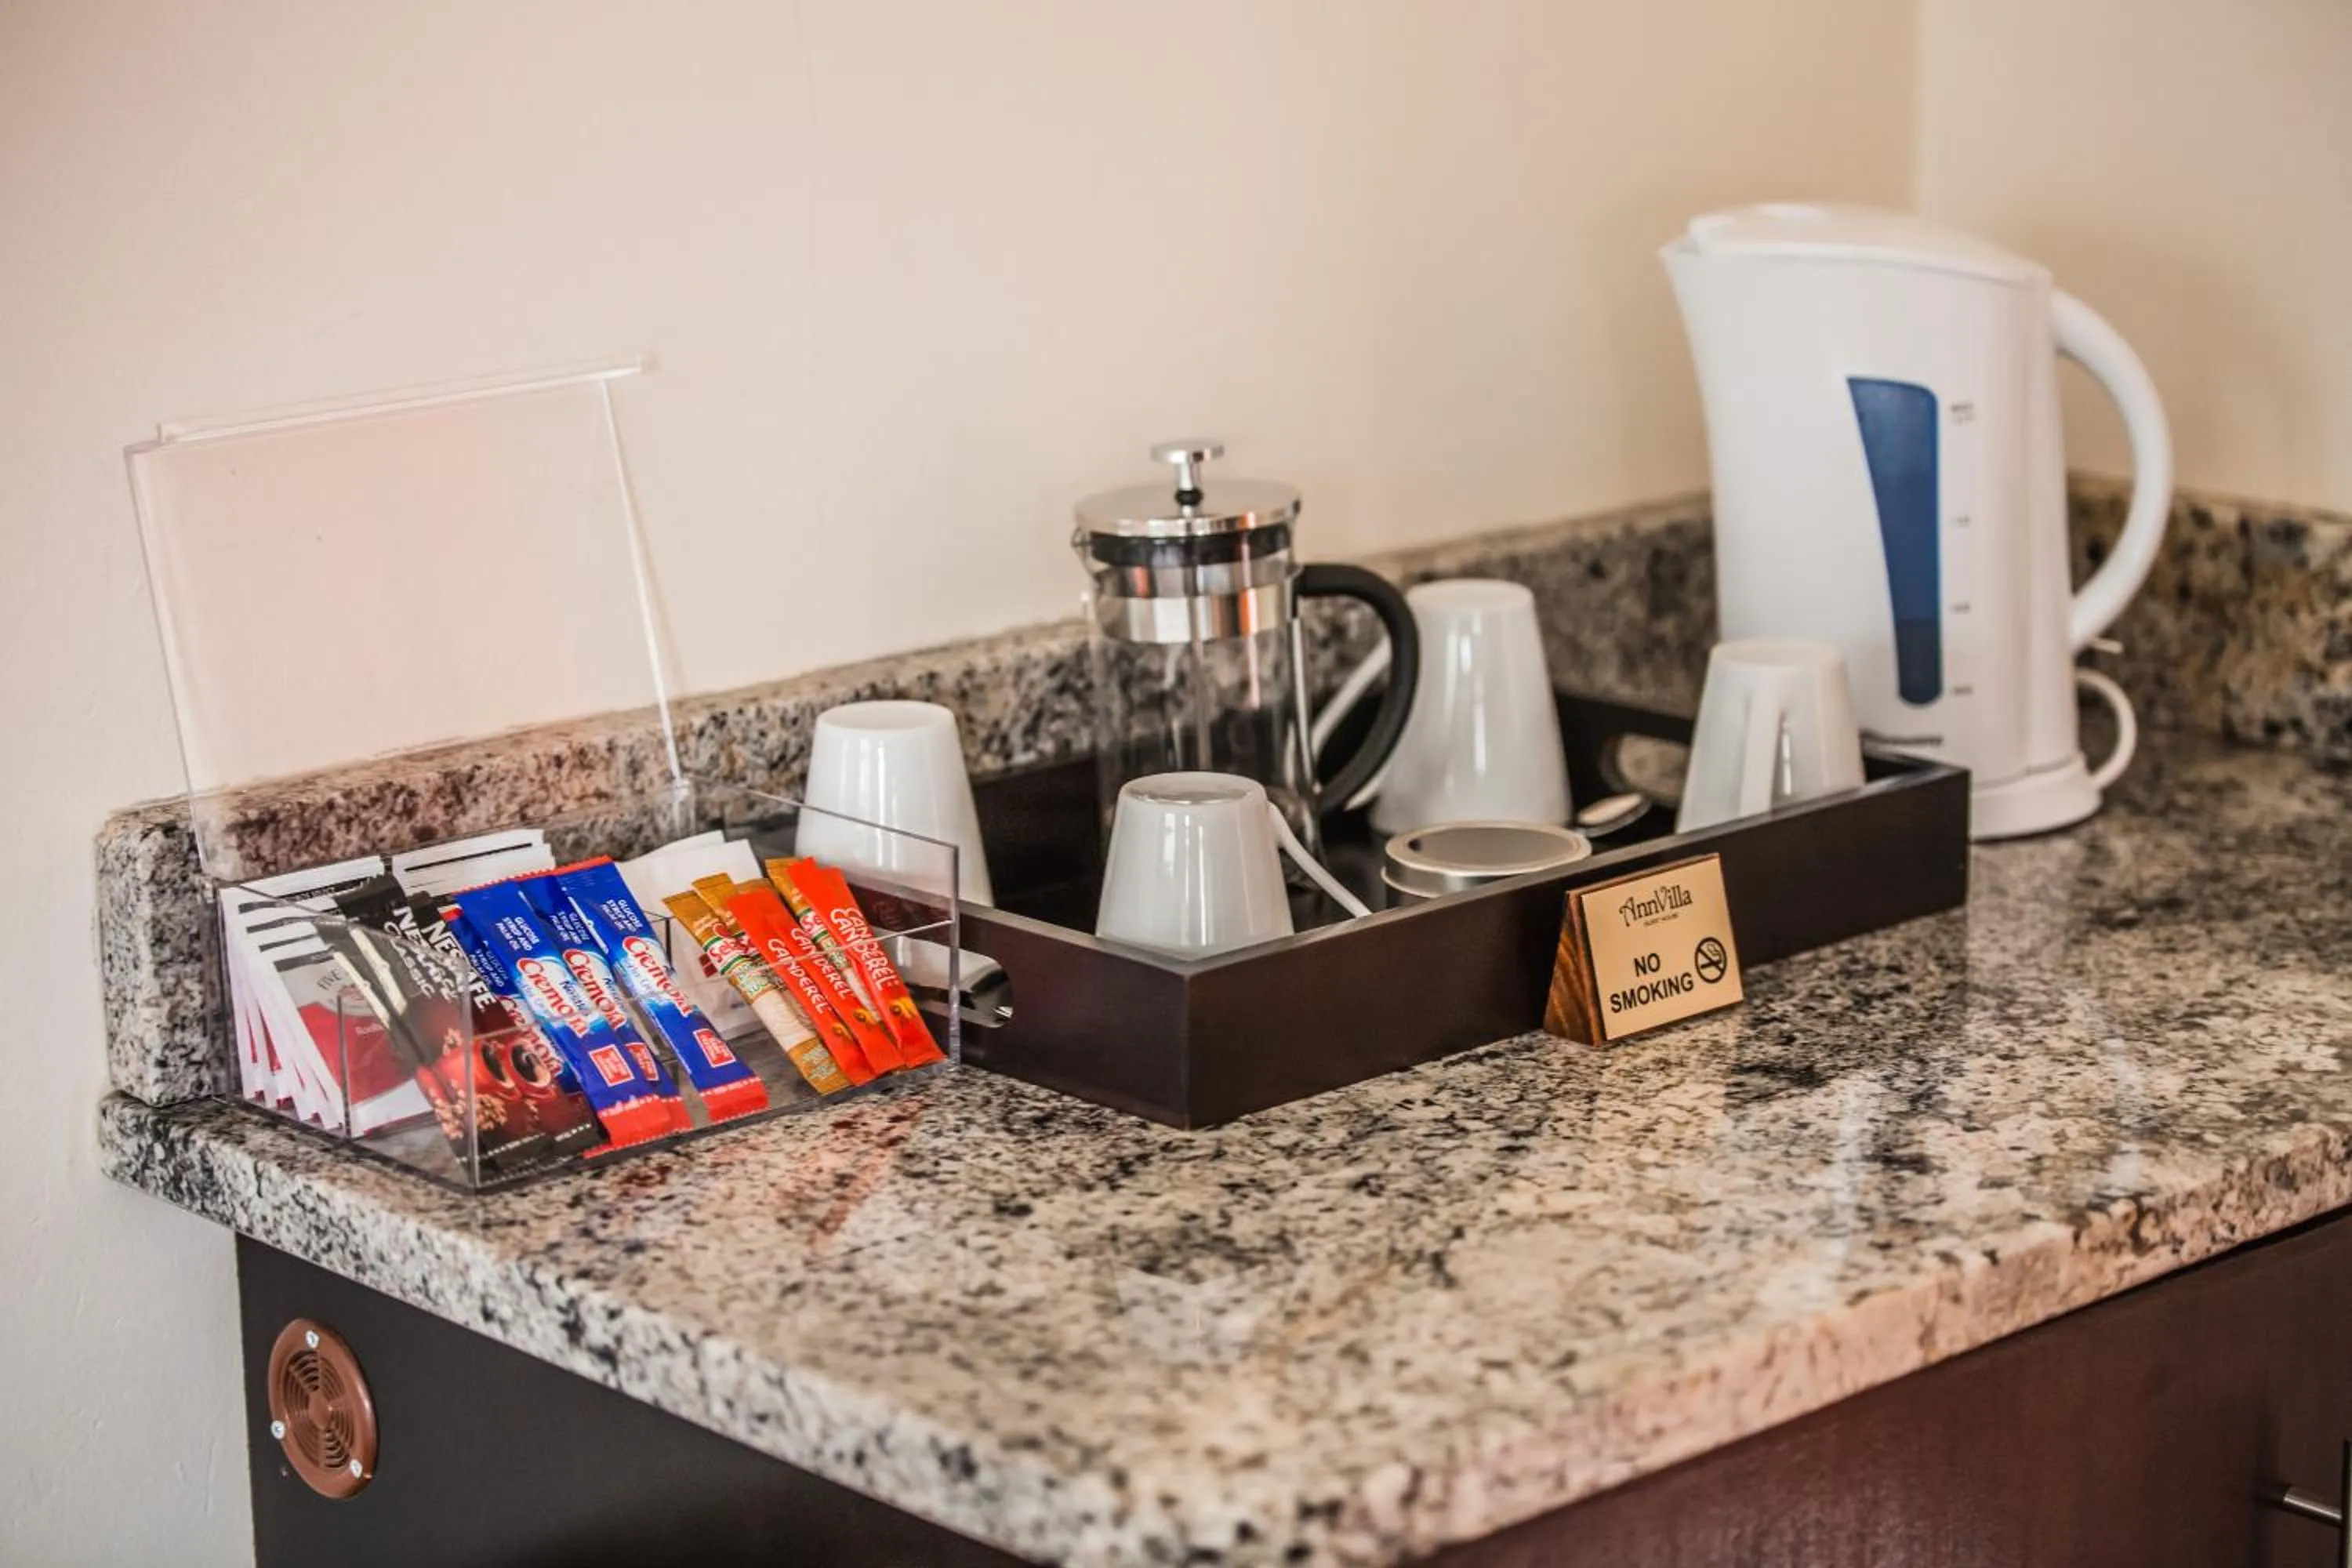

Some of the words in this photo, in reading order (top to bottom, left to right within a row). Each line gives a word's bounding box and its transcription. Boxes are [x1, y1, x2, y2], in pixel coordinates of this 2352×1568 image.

[514, 916, 540, 945] GLUCOSE
[1619, 884, 1693, 927] AnnVilla
[563, 949, 626, 1029] Cremora
[768, 938, 830, 1014] CANDEREL
[791, 928, 851, 1000] CANDEREL
[1610, 972, 1693, 1013] SMOKING
[1634, 953, 1661, 978] NO
[517, 958, 588, 1037] Cremora
